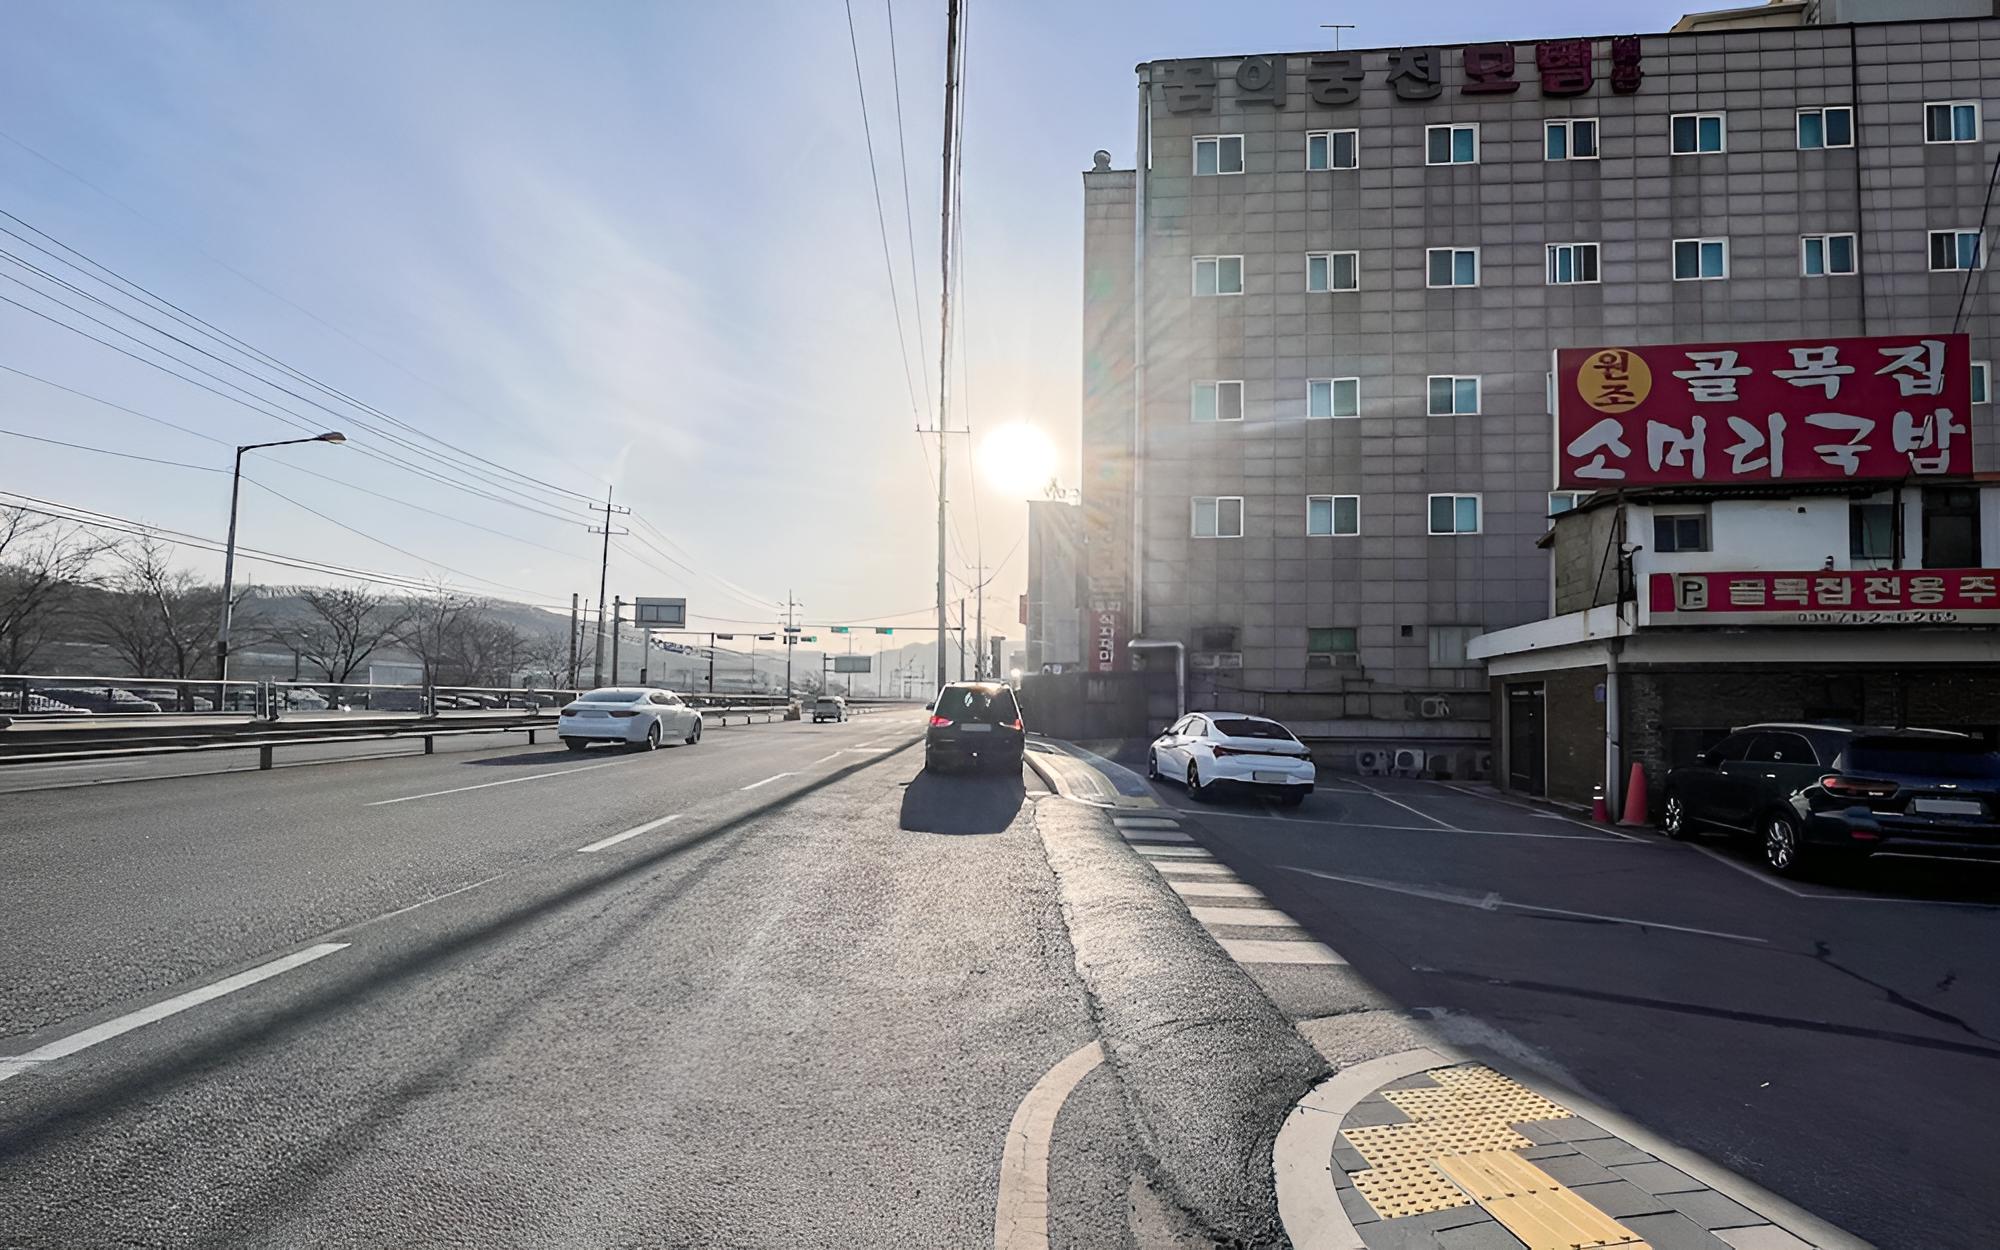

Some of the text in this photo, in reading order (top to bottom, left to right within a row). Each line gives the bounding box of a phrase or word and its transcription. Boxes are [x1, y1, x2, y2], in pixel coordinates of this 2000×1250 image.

[1593, 348, 1637, 406] 원조
[1672, 340, 1946, 402] 골목집
[1567, 407, 1967, 480] 소머리국밥
